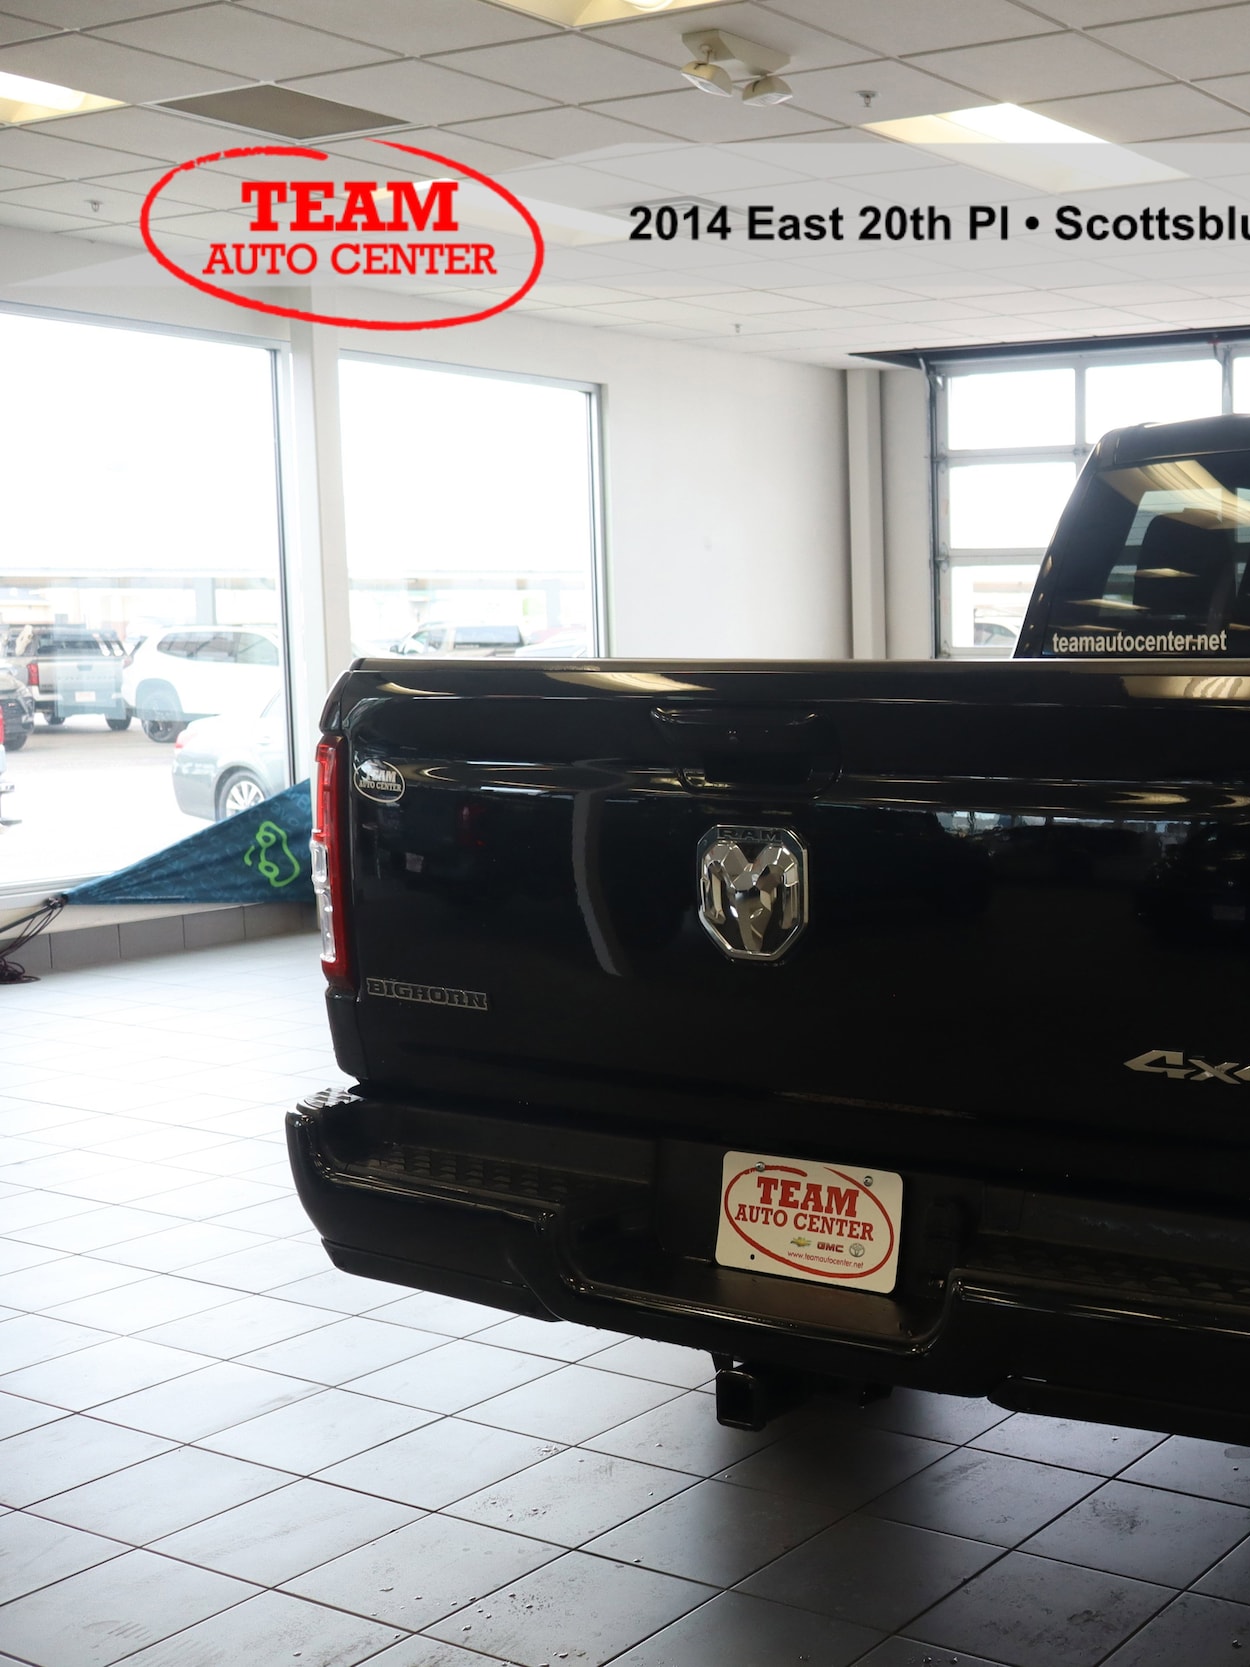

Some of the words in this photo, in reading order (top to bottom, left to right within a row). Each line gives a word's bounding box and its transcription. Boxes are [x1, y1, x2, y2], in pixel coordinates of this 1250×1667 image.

[1052, 629, 1227, 653] teamautocenter.net
[375, 781, 402, 792] CENTER
[717, 828, 783, 843] RAM
[366, 977, 488, 1011] BIGHORN
[757, 1175, 860, 1218] TEAM
[734, 1203, 789, 1228] AUTO
[793, 1212, 875, 1242] CENTER
[816, 1241, 845, 1254] GMC
[787, 1250, 864, 1269] www.teamautocenter.net
